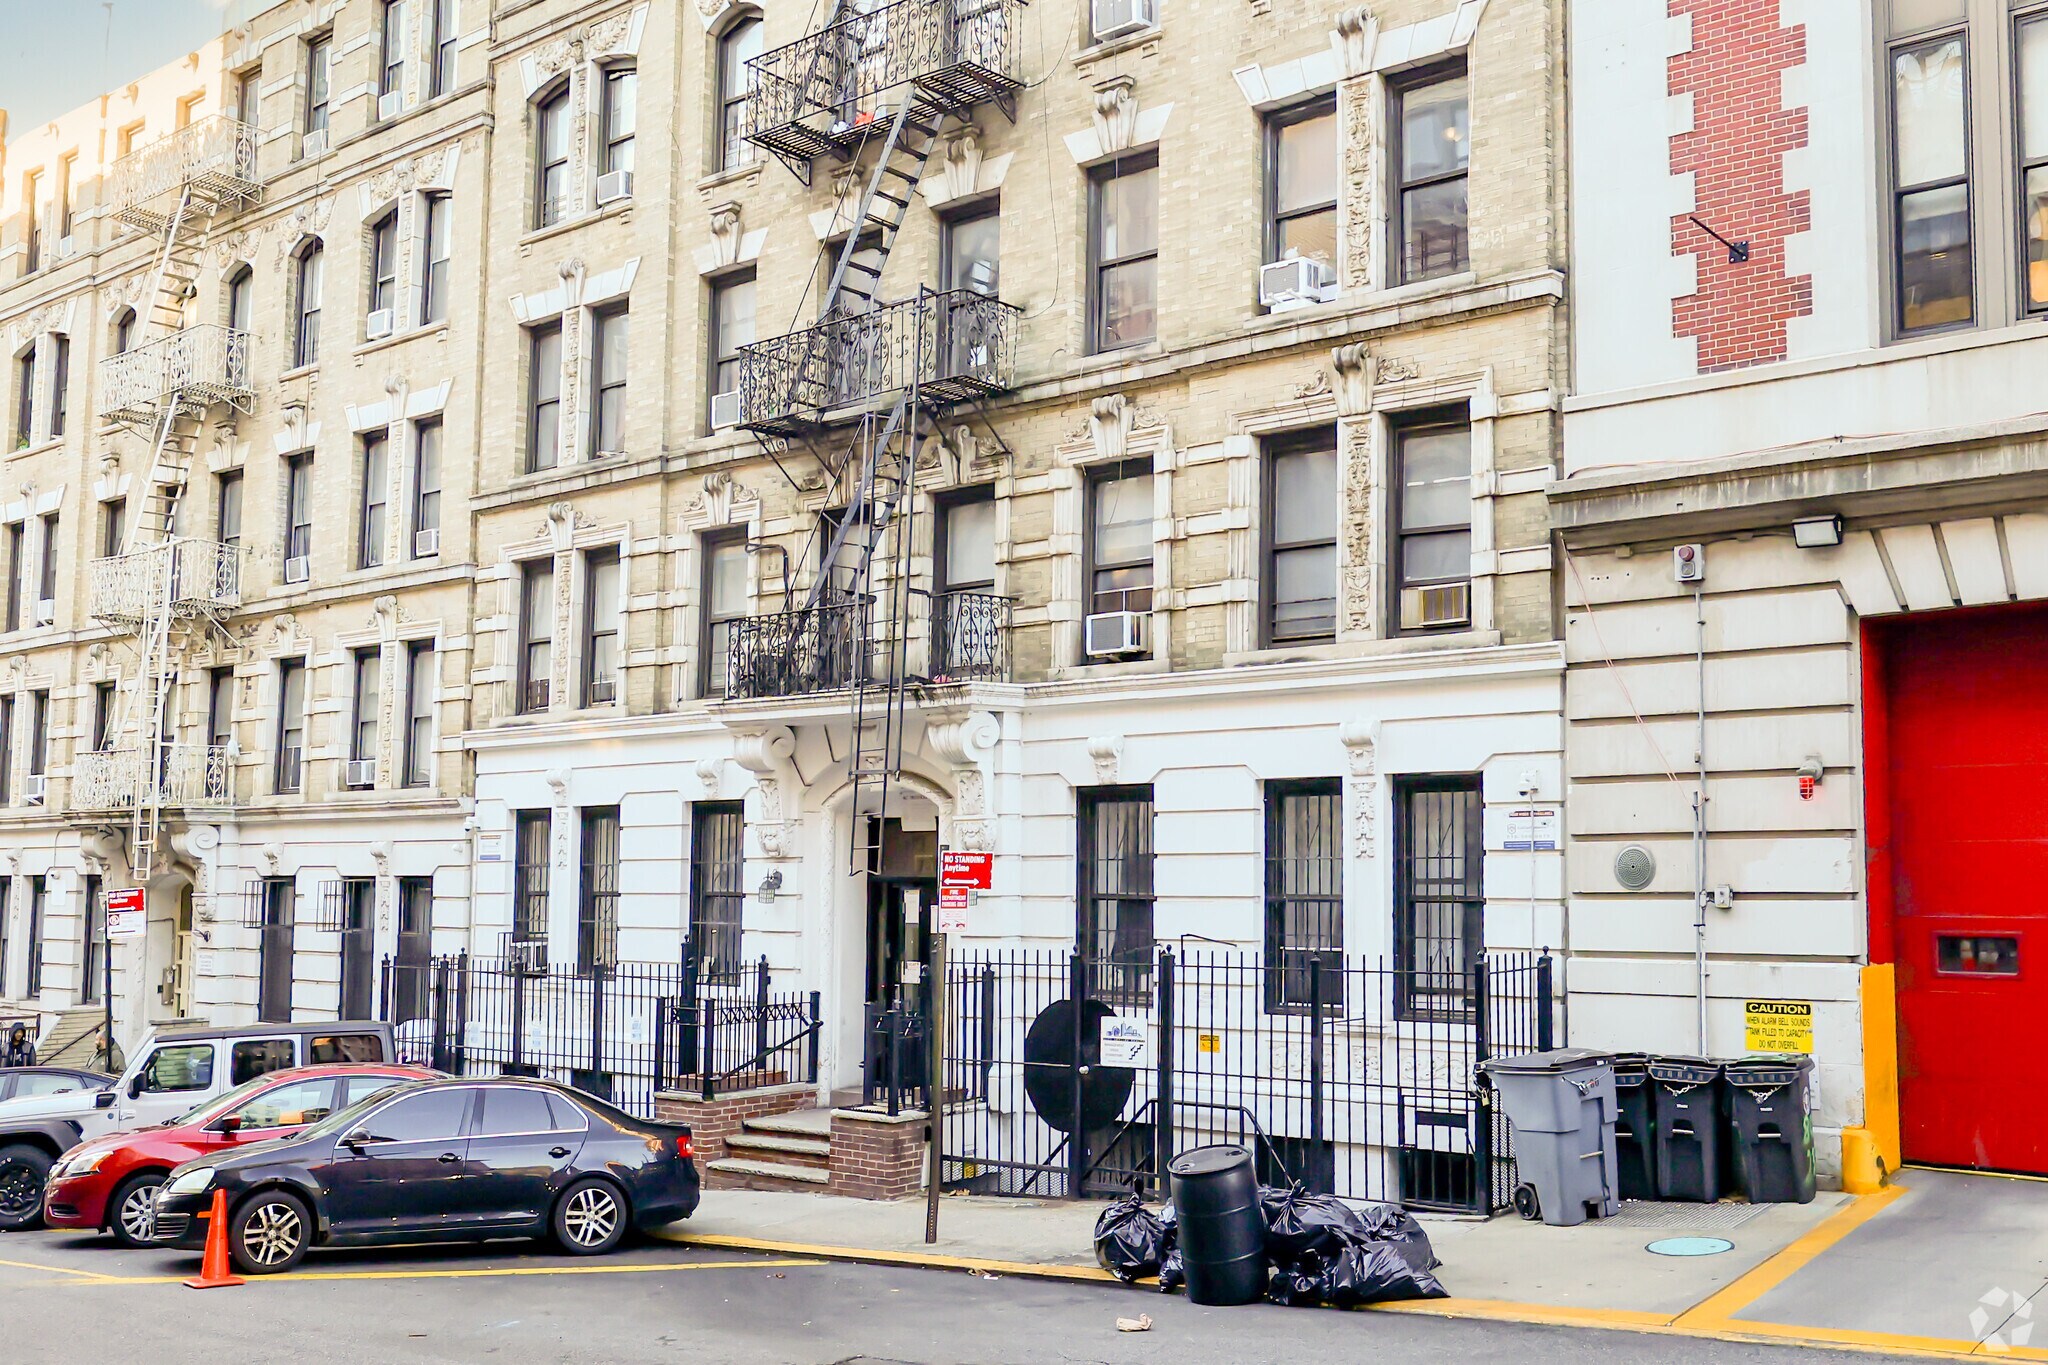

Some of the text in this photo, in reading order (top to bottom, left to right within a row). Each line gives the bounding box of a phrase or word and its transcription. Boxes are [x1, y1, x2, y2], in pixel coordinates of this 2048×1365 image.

[944, 855, 986, 864] NO STANDING
[944, 864, 970, 873] Anytime
[1748, 1003, 1808, 1014] CAUTION
[1746, 1016, 1811, 1027] WHEN ALARM BELL SOUNDS
[1761, 1027, 1777, 1037] FILLED
[1778, 1028, 1786, 1037] TO
[1758, 1039, 1799, 1050] DO NOT OVERFILL
